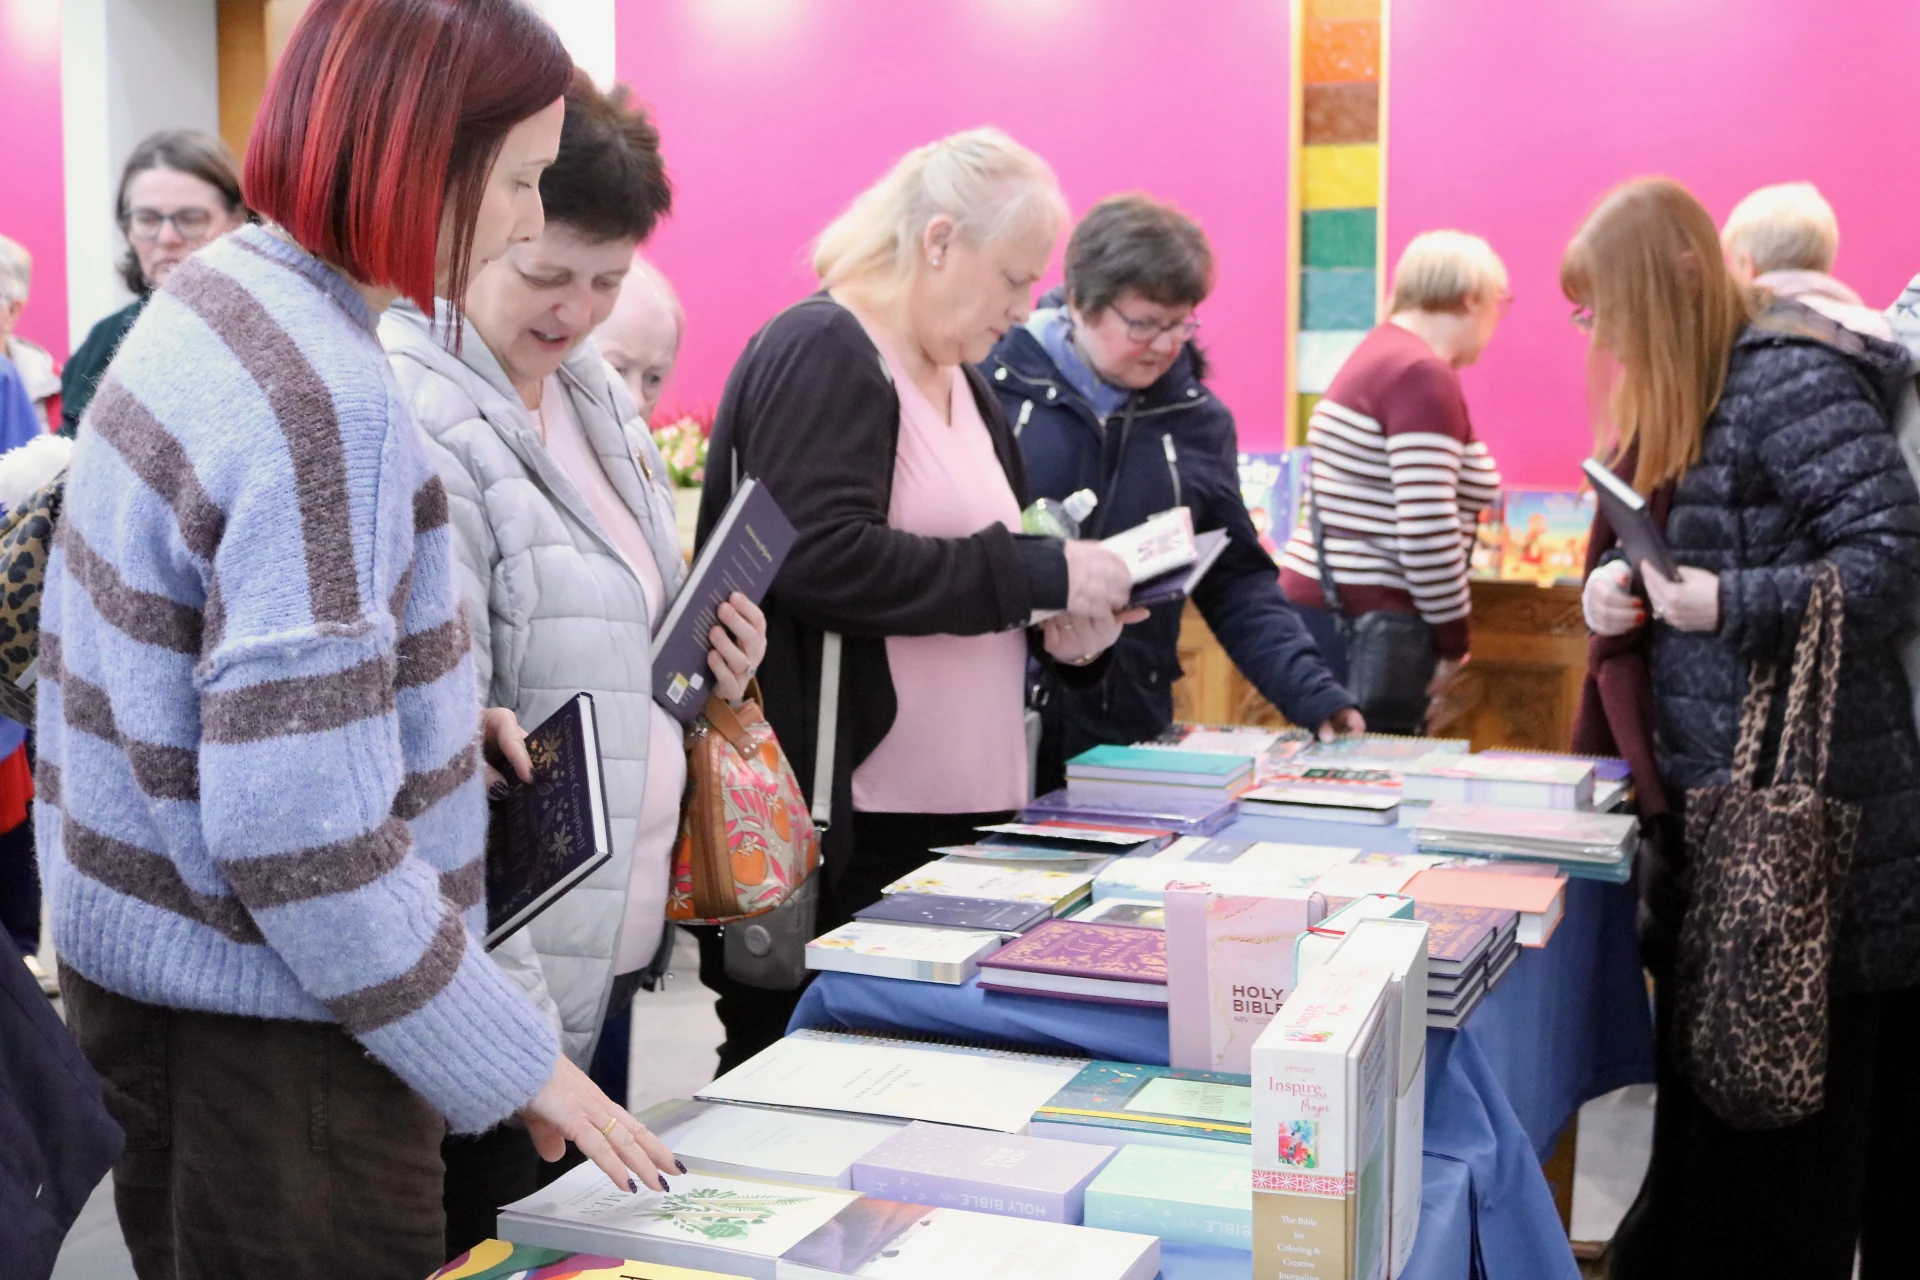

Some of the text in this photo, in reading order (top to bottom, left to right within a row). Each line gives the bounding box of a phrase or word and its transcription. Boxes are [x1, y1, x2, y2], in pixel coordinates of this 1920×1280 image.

[563, 713, 586, 851] Catherine Campbell
[1232, 984, 1284, 1001] HOLY
[1269, 1076, 1326, 1098] Inspire
[1301, 1098, 1330, 1118] Prayer
[960, 1193, 1004, 1211] BIBLE
[1008, 1201, 1046, 1217] HOLY
[1204, 1220, 1252, 1237] BIBLE
[1281, 1215, 1318, 1227] The Bible
[1293, 1231, 1305, 1239] for
[1277, 1243, 1313, 1256] Coloring
[1282, 1258, 1316, 1268] Creative
